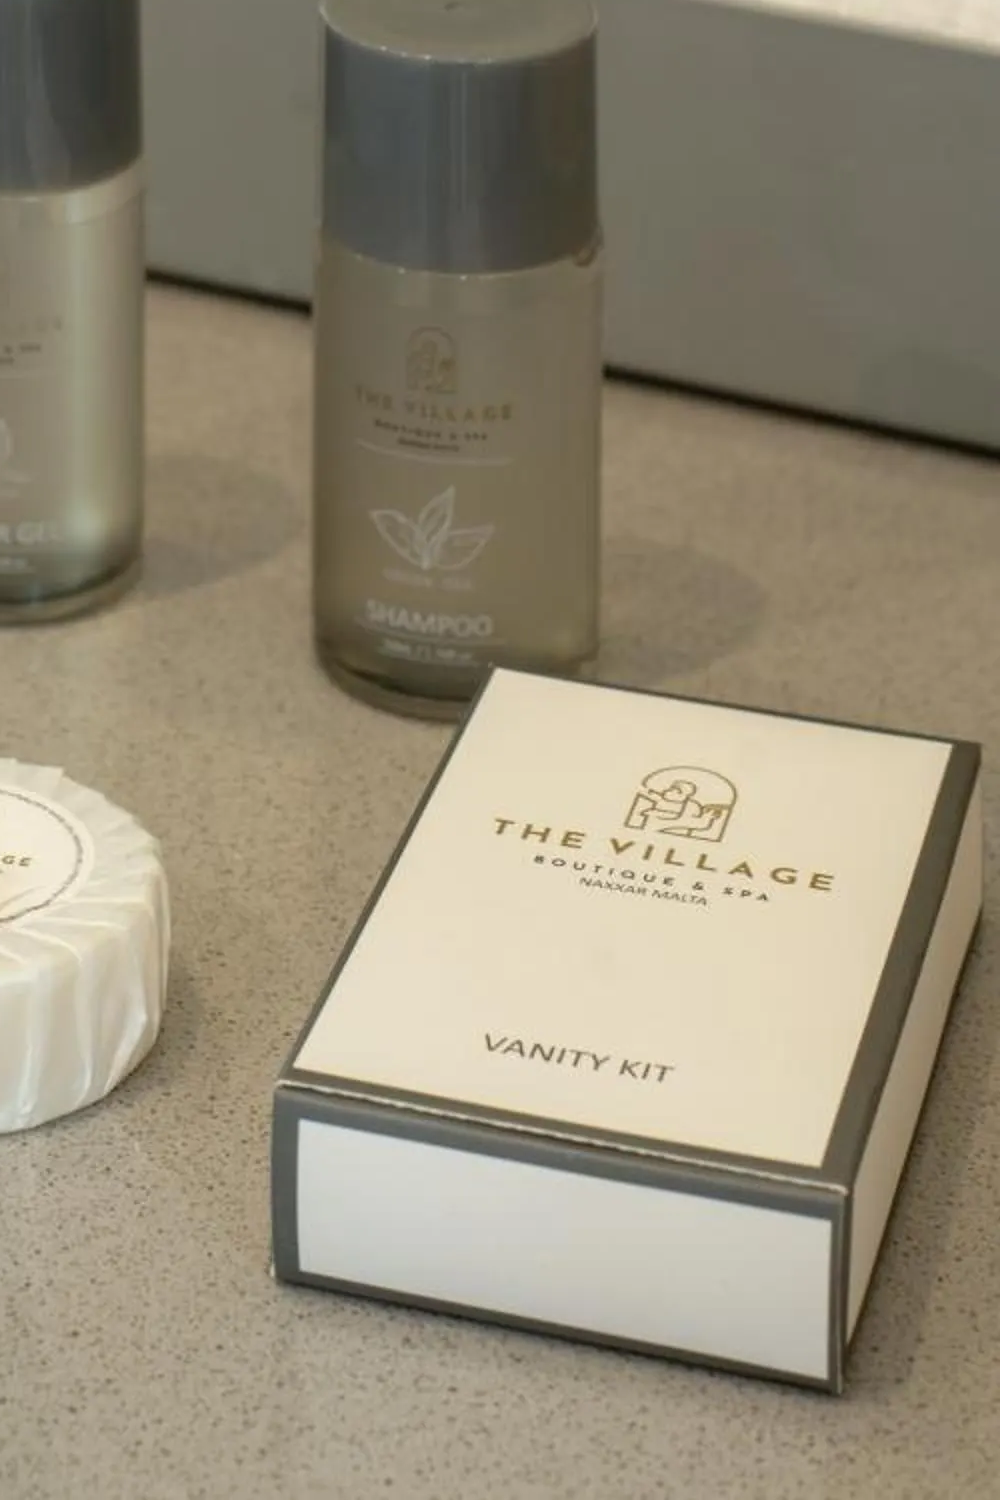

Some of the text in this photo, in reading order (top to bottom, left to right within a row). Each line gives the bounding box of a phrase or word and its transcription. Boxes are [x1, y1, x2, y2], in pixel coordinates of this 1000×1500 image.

[365, 598, 495, 638] SHAMPOO
[494, 817, 836, 892] THE VILLAGE
[533, 854, 771, 902] BOUTIQUE & SPA
[578, 876, 709, 907] NAXXAR MALTA
[484, 1032, 676, 1084] VANITY KIT
